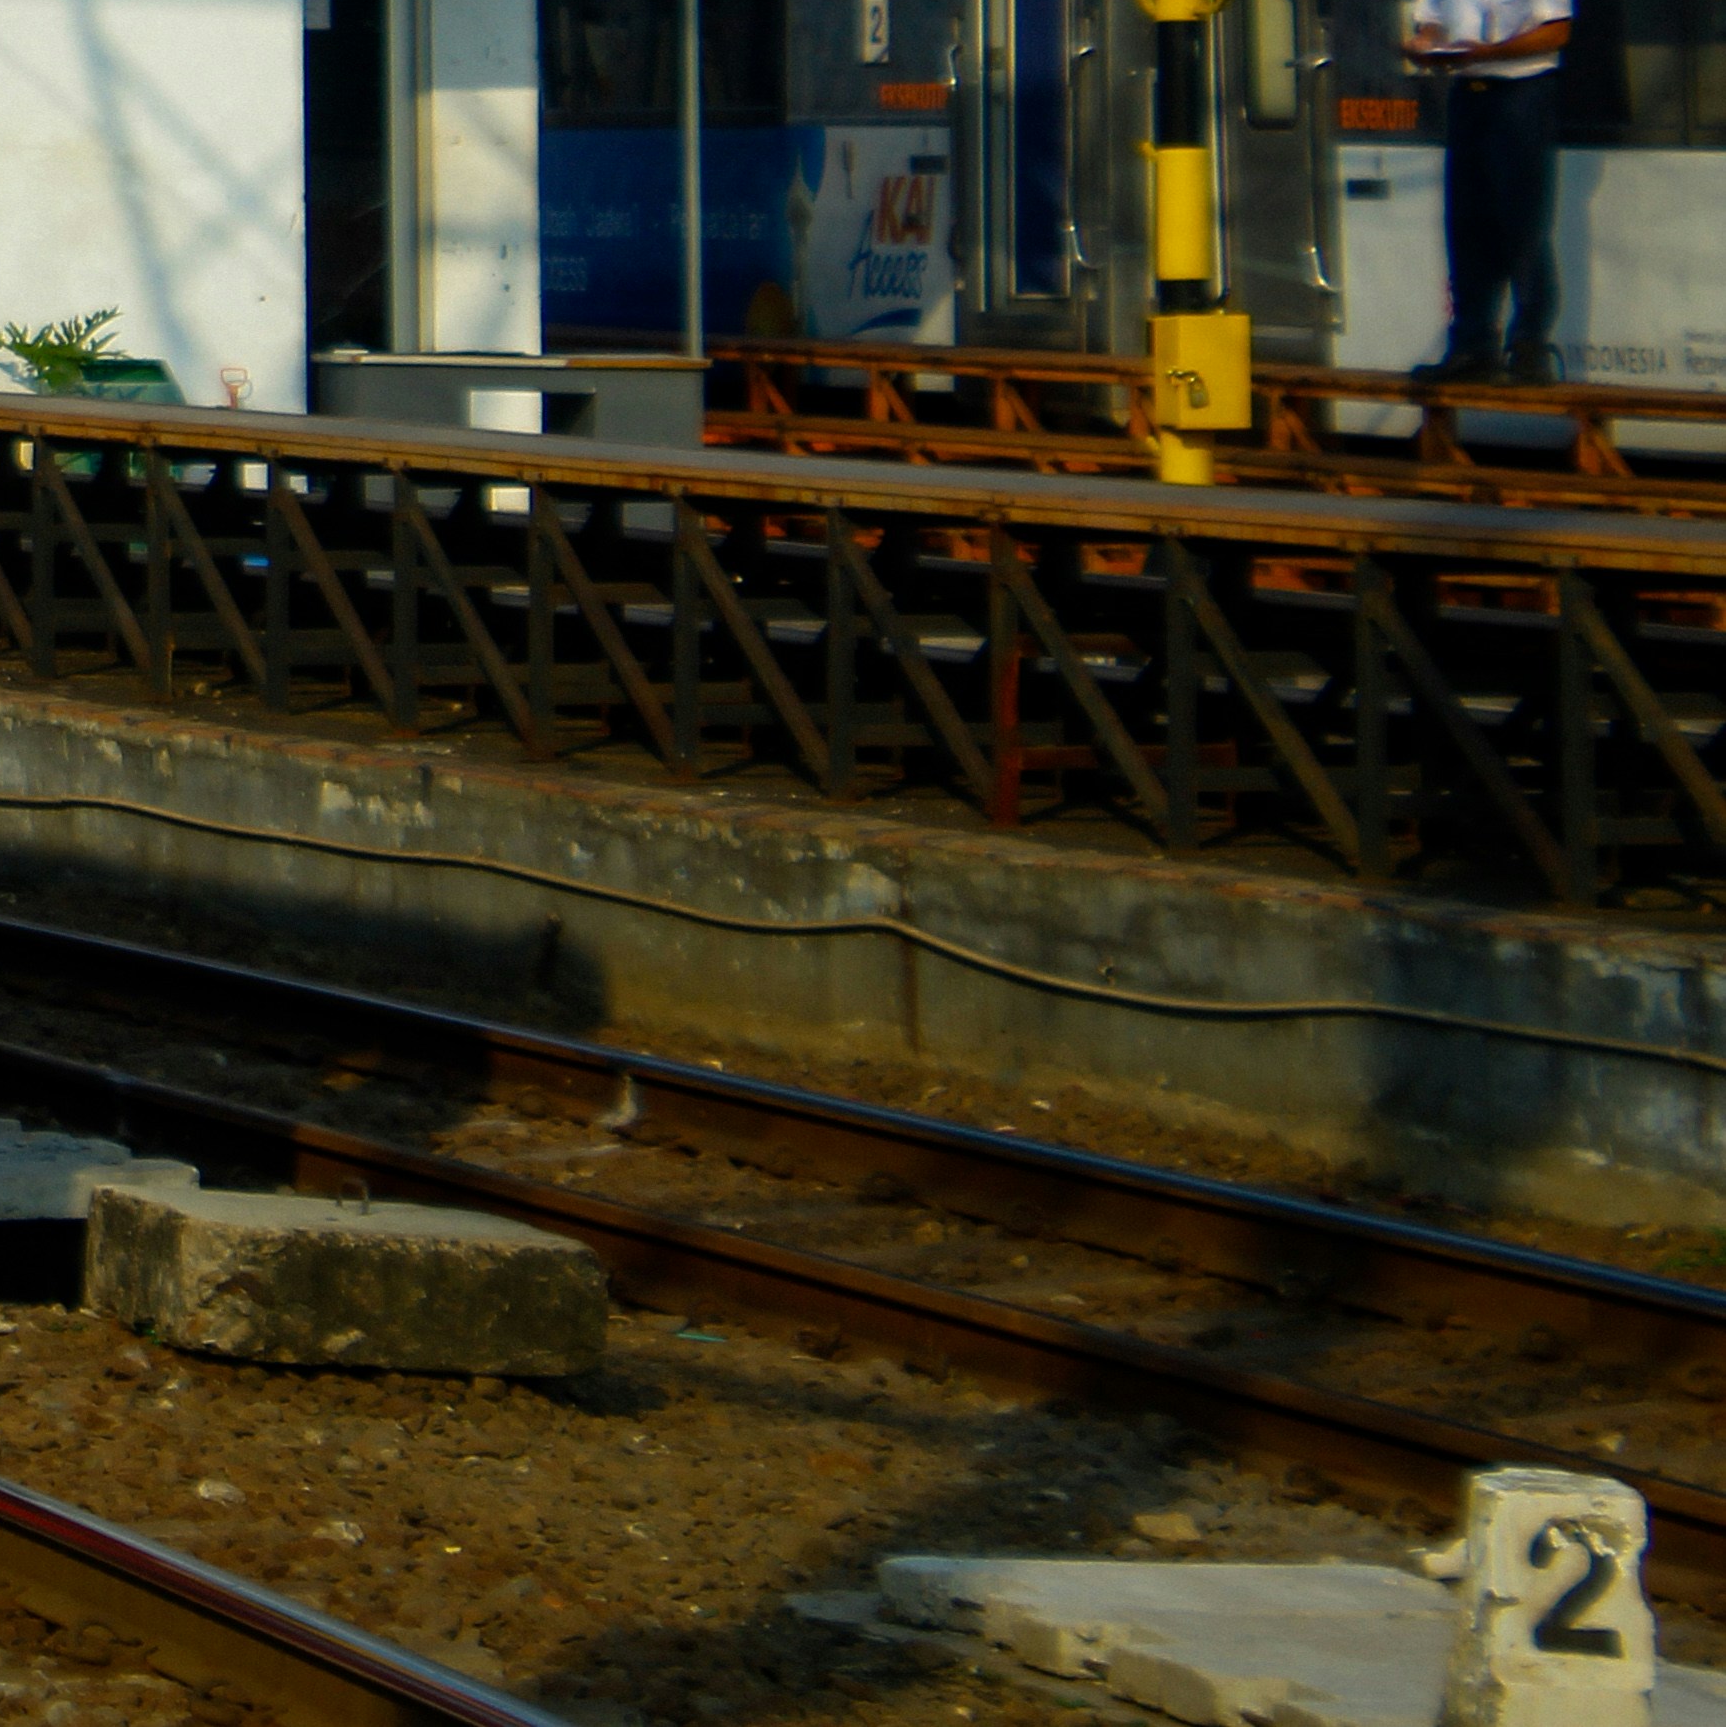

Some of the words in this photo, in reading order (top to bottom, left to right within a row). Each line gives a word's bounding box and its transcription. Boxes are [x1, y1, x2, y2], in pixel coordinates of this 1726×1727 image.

[870, 5, 883, 45] 2
[876, 175, 936, 247] KAI
[1528, 1516, 1622, 1660] 2
